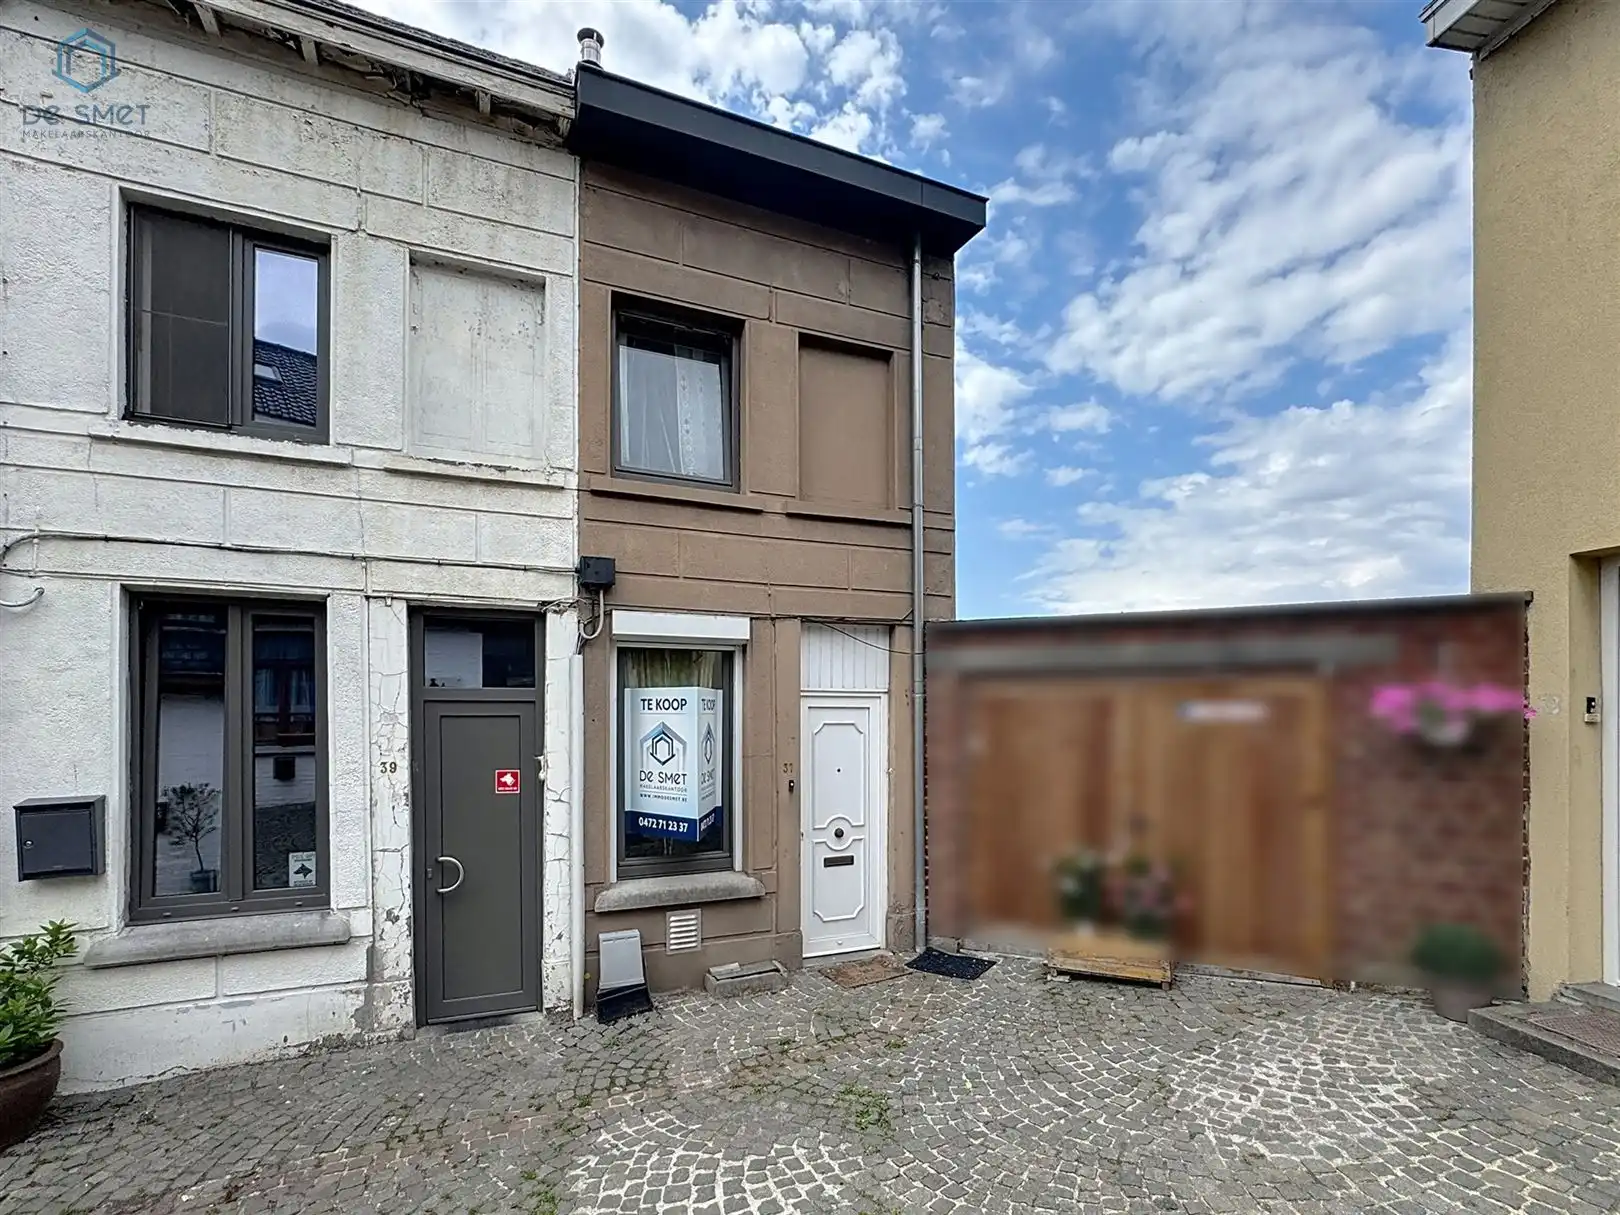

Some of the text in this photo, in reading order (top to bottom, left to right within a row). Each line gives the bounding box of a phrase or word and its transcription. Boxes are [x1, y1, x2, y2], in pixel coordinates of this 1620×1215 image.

[640, 698, 654, 711] TE
[655, 698, 688, 711] KOOP
[380, 761, 397, 774] 39
[783, 762, 793, 774] 37
[638, 816, 689, 833] 0472 71 23 37
